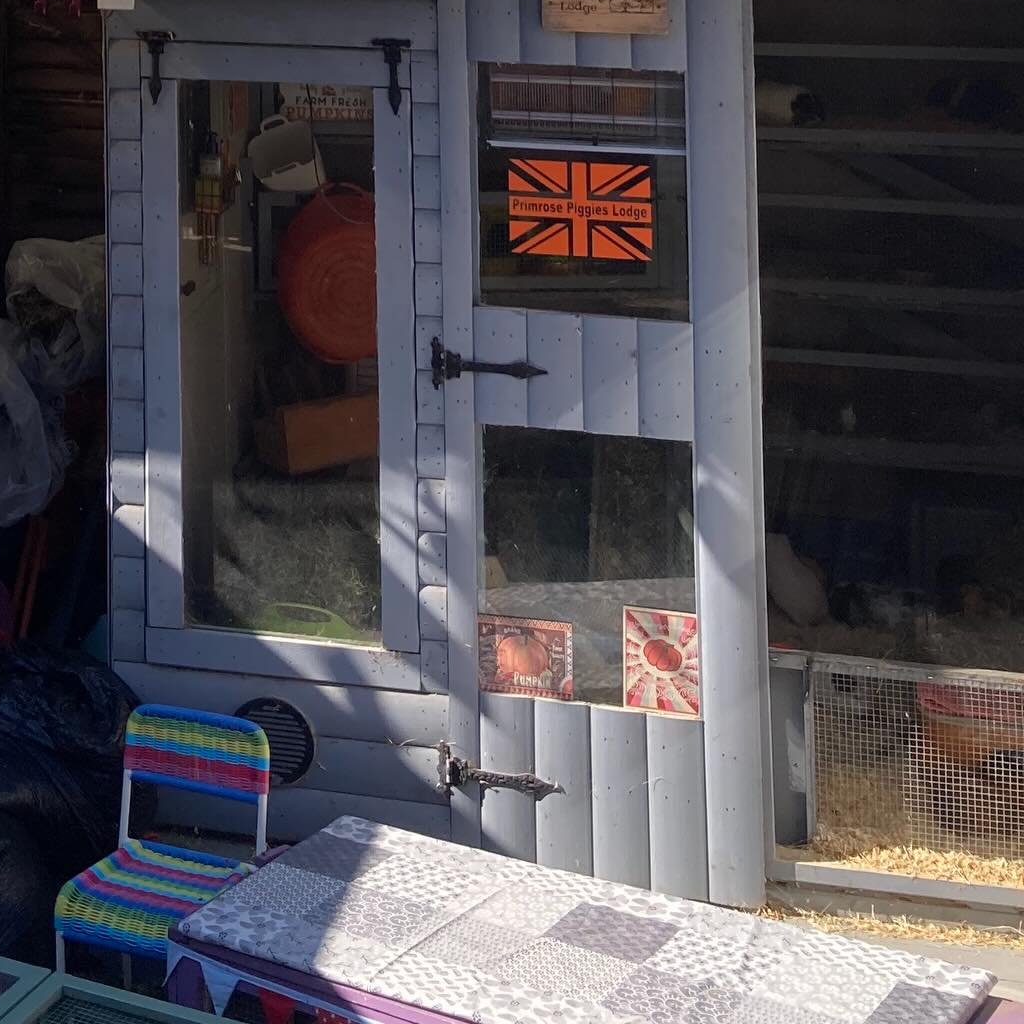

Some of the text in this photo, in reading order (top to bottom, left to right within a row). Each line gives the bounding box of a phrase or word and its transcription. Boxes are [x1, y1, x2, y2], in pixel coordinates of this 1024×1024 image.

[560, 1, 597, 15] Lodge
[296, 96, 326, 106] FARM
[512, 199, 647, 220] Primrose Piggies Lodge
